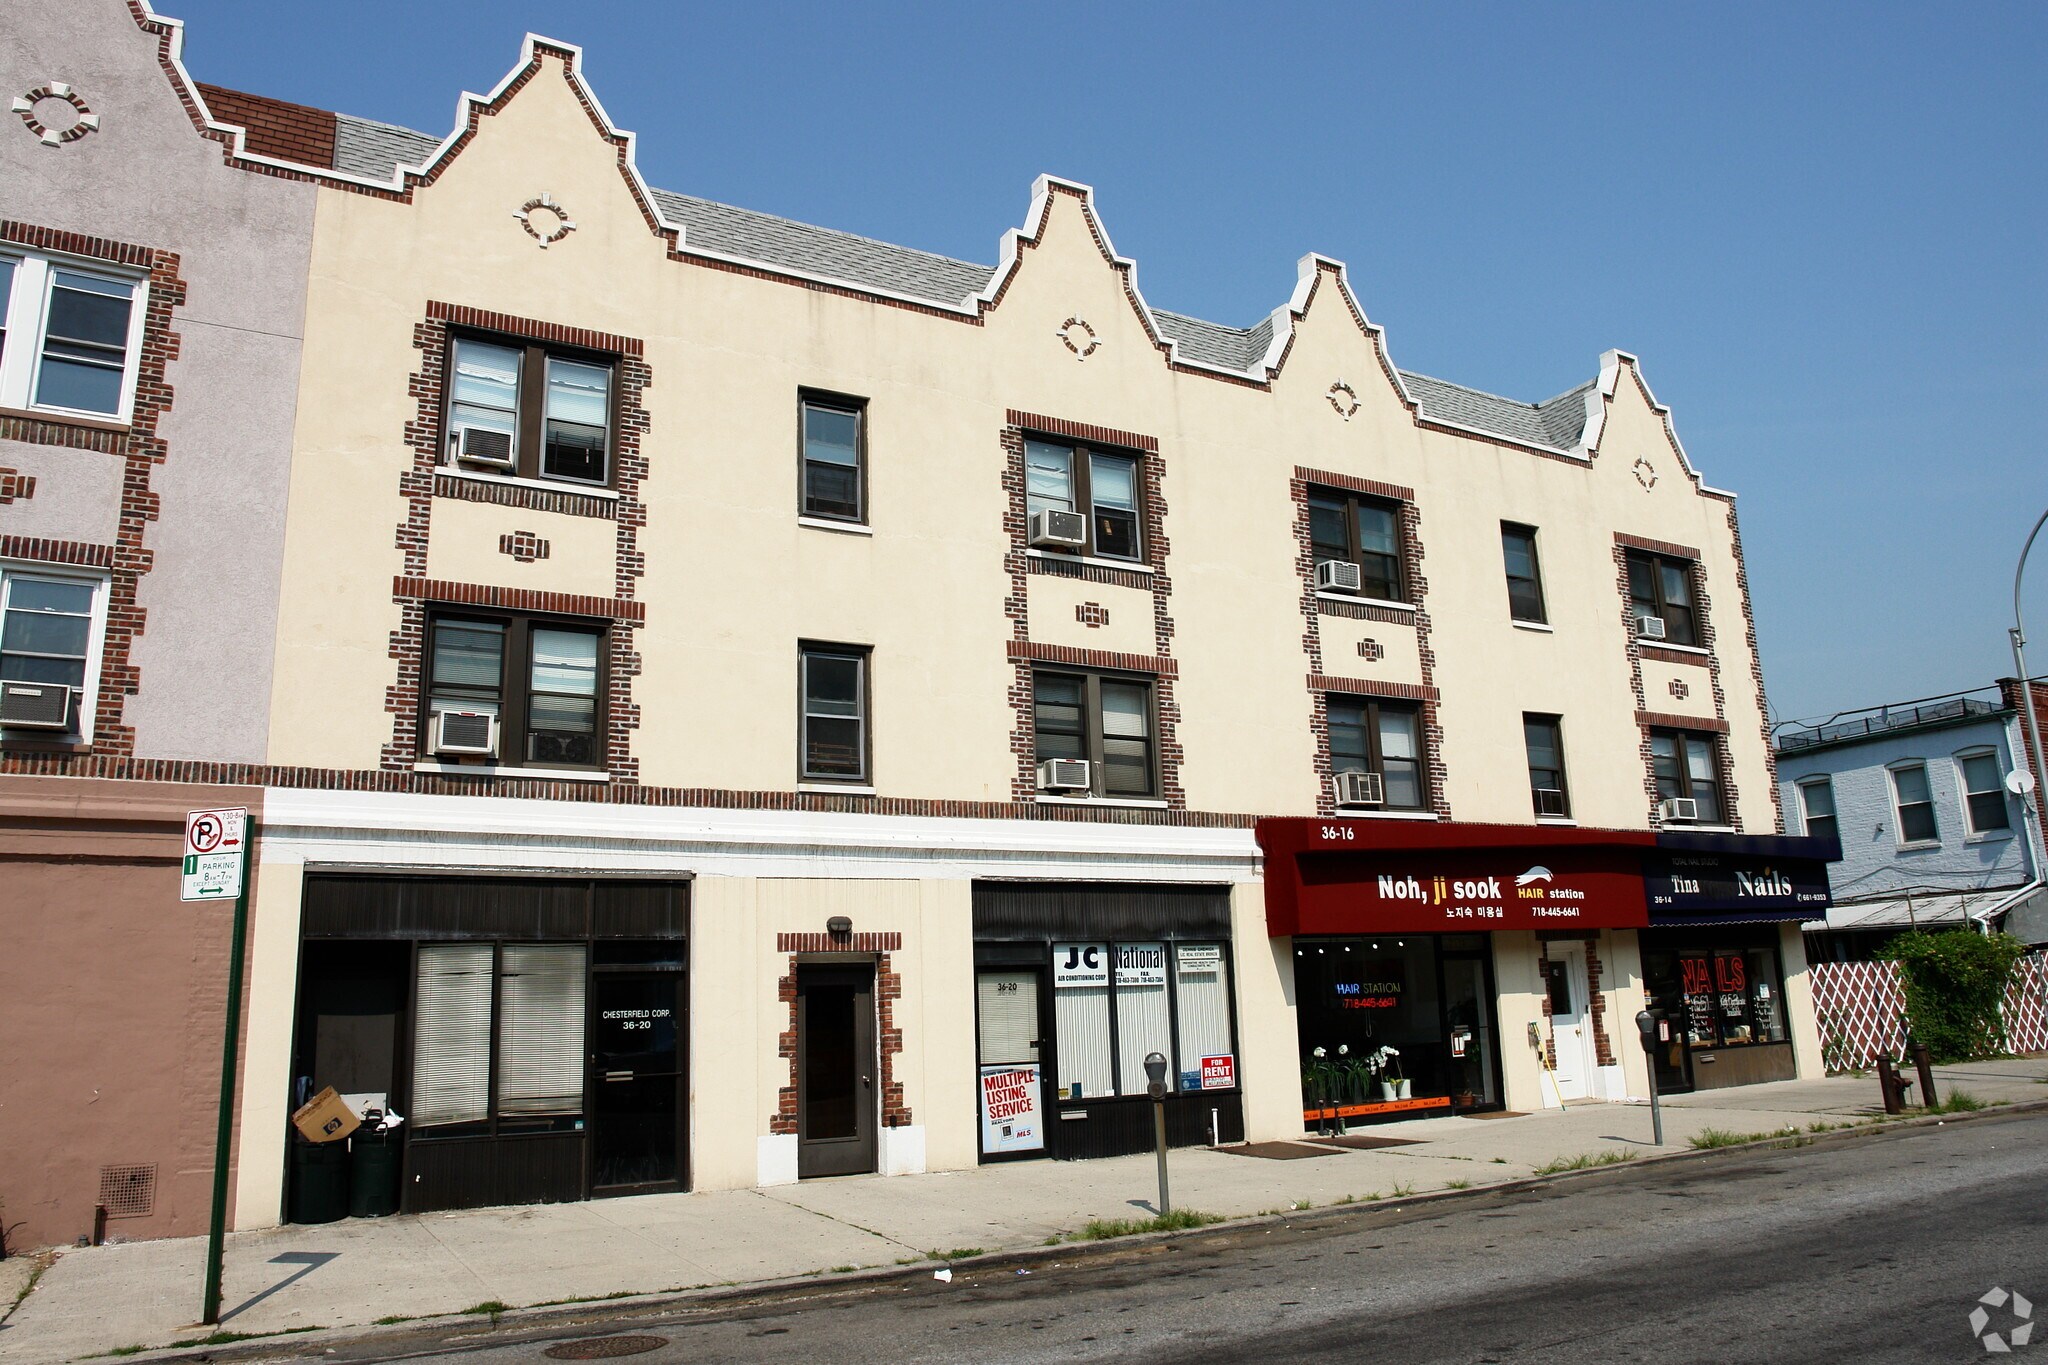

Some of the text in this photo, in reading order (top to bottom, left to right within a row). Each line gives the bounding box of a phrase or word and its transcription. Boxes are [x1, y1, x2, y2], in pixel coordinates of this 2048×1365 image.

[1321, 826, 1355, 840] 36-16
[202, 861, 235, 871] PARKING
[1671, 866, 1793, 897] Tina Nails
[1378, 875, 1502, 905] Noh, ji sook
[1518, 888, 1585, 899] HAIR station
[1654, 896, 1672, 904] 36-14
[1803, 893, 1827, 901] 661-9353
[1446, 906, 1504, 918] 노지숙 미용실
[1532, 907, 1580, 917] 718-445-6641
[1063, 946, 1099, 970] JC
[1115, 946, 1163, 969] National
[1066, 974, 1094, 982] CONDITIONING
[1680, 956, 1746, 994] NAILS
[997, 982, 1017, 991] 36-20
[1336, 982, 1401, 995] HAIR STATION
[602, 1009, 672, 1019] CHESTERFIELD CORP.
[623, 1021, 651, 1030] 36-20
[1204, 1066, 1231, 1077] RENT
[984, 1069, 1035, 1091] MULTIPLE
[986, 1085, 1027, 1105] LISTING
[989, 1098, 1034, 1119] SERVICE
[1016, 1129, 1031, 1138] MLS
